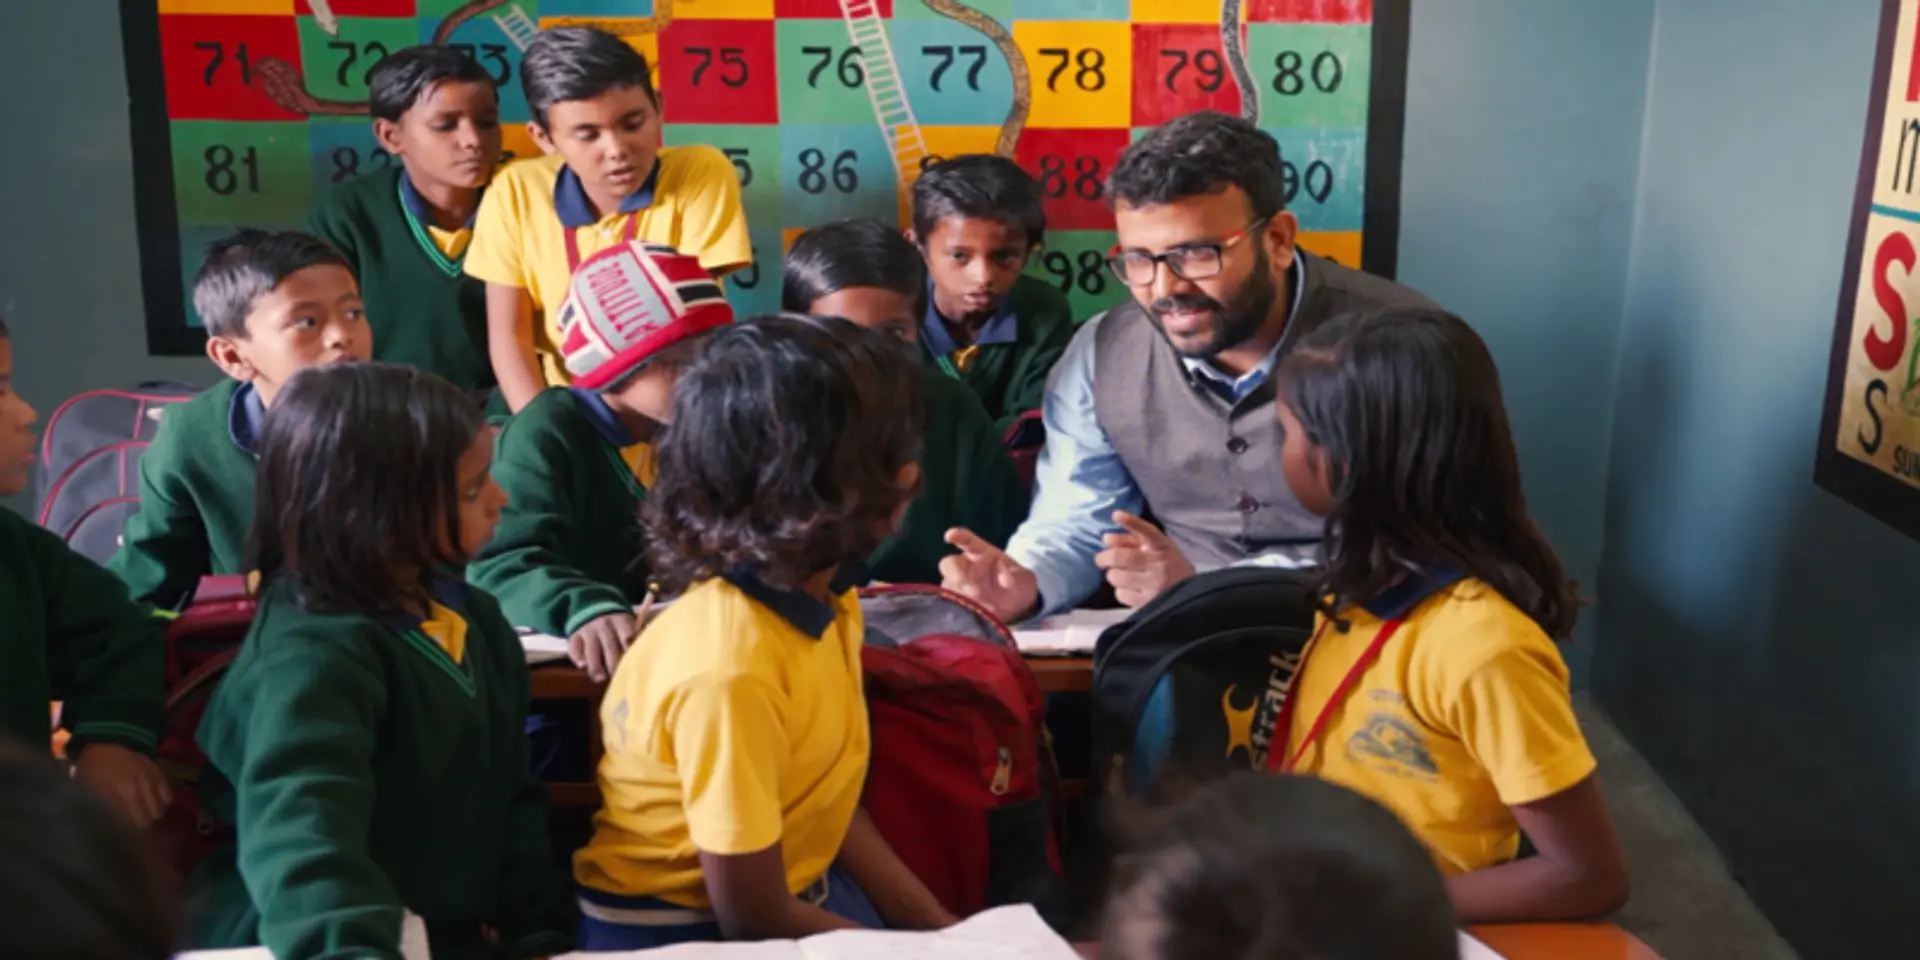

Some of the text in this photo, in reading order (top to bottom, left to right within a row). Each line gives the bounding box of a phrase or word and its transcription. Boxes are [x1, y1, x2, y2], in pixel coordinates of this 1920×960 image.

[194, 41, 252, 86] 71
[684, 46, 750, 88] 75
[801, 46, 865, 89] 76
[921, 45, 987, 92] 77
[1037, 48, 1106, 93] 78
[1159, 49, 1225, 93] 79
[1272, 50, 1343, 96] 80
[204, 144, 259, 195] 81
[722, 147, 753, 188] 5
[798, 147, 859, 194] 86
[1039, 153, 1106, 202] 88
[1043, 249, 1106, 296] 98
[1863, 231, 1916, 371] S
